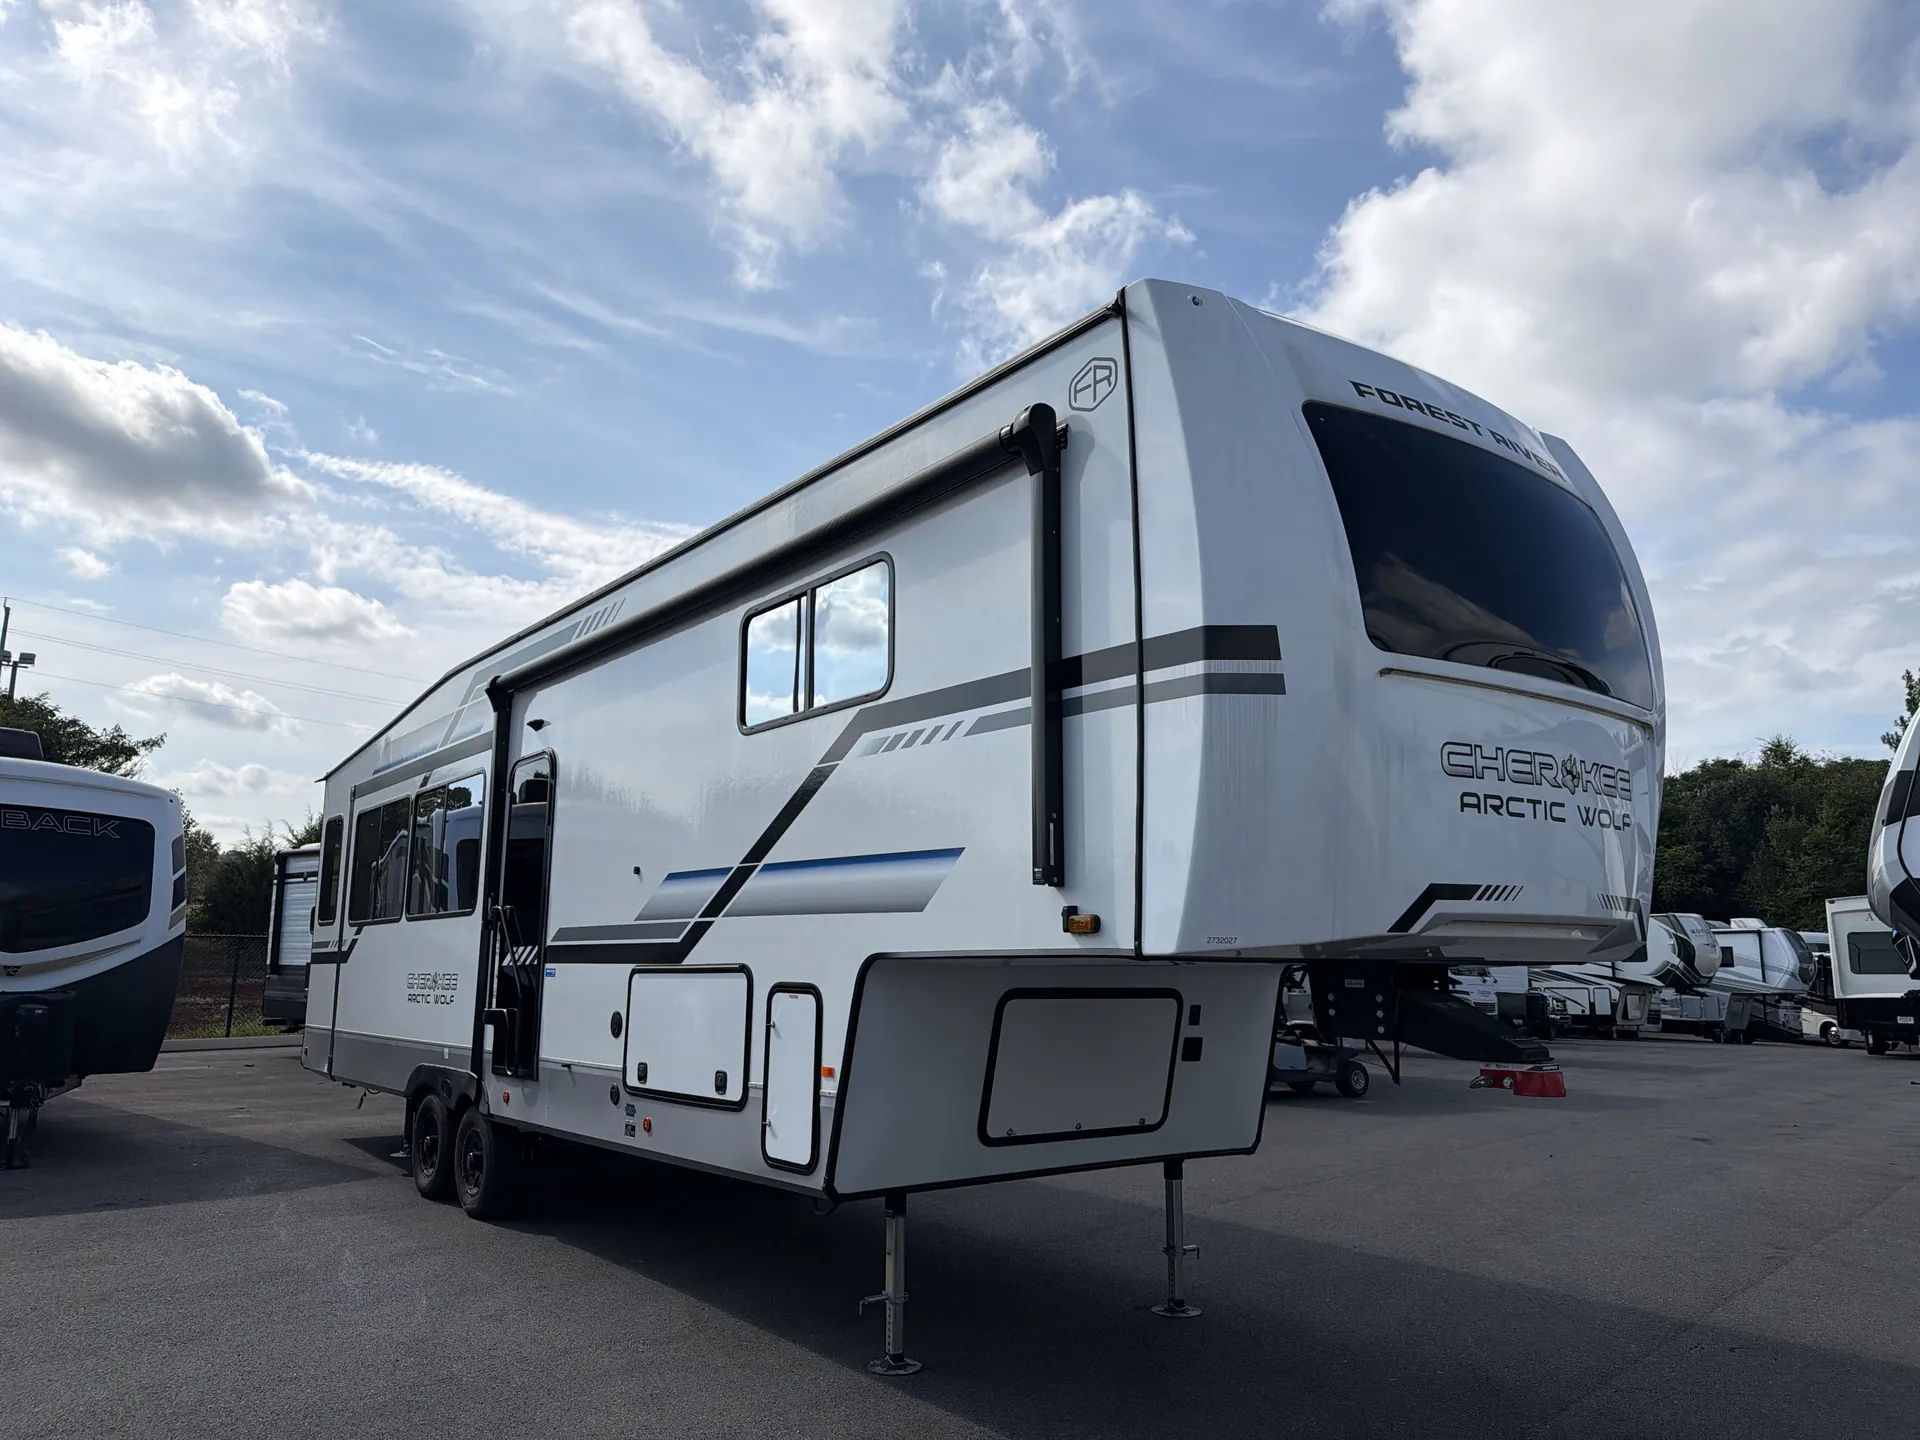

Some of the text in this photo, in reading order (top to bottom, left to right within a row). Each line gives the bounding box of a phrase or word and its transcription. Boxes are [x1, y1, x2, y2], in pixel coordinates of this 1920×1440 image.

[1348, 379, 1568, 484] FOREST RIVER
[1459, 791, 1632, 832] ARCTIC WOLF
[406, 993, 455, 1005] ARCTIC WOLF
